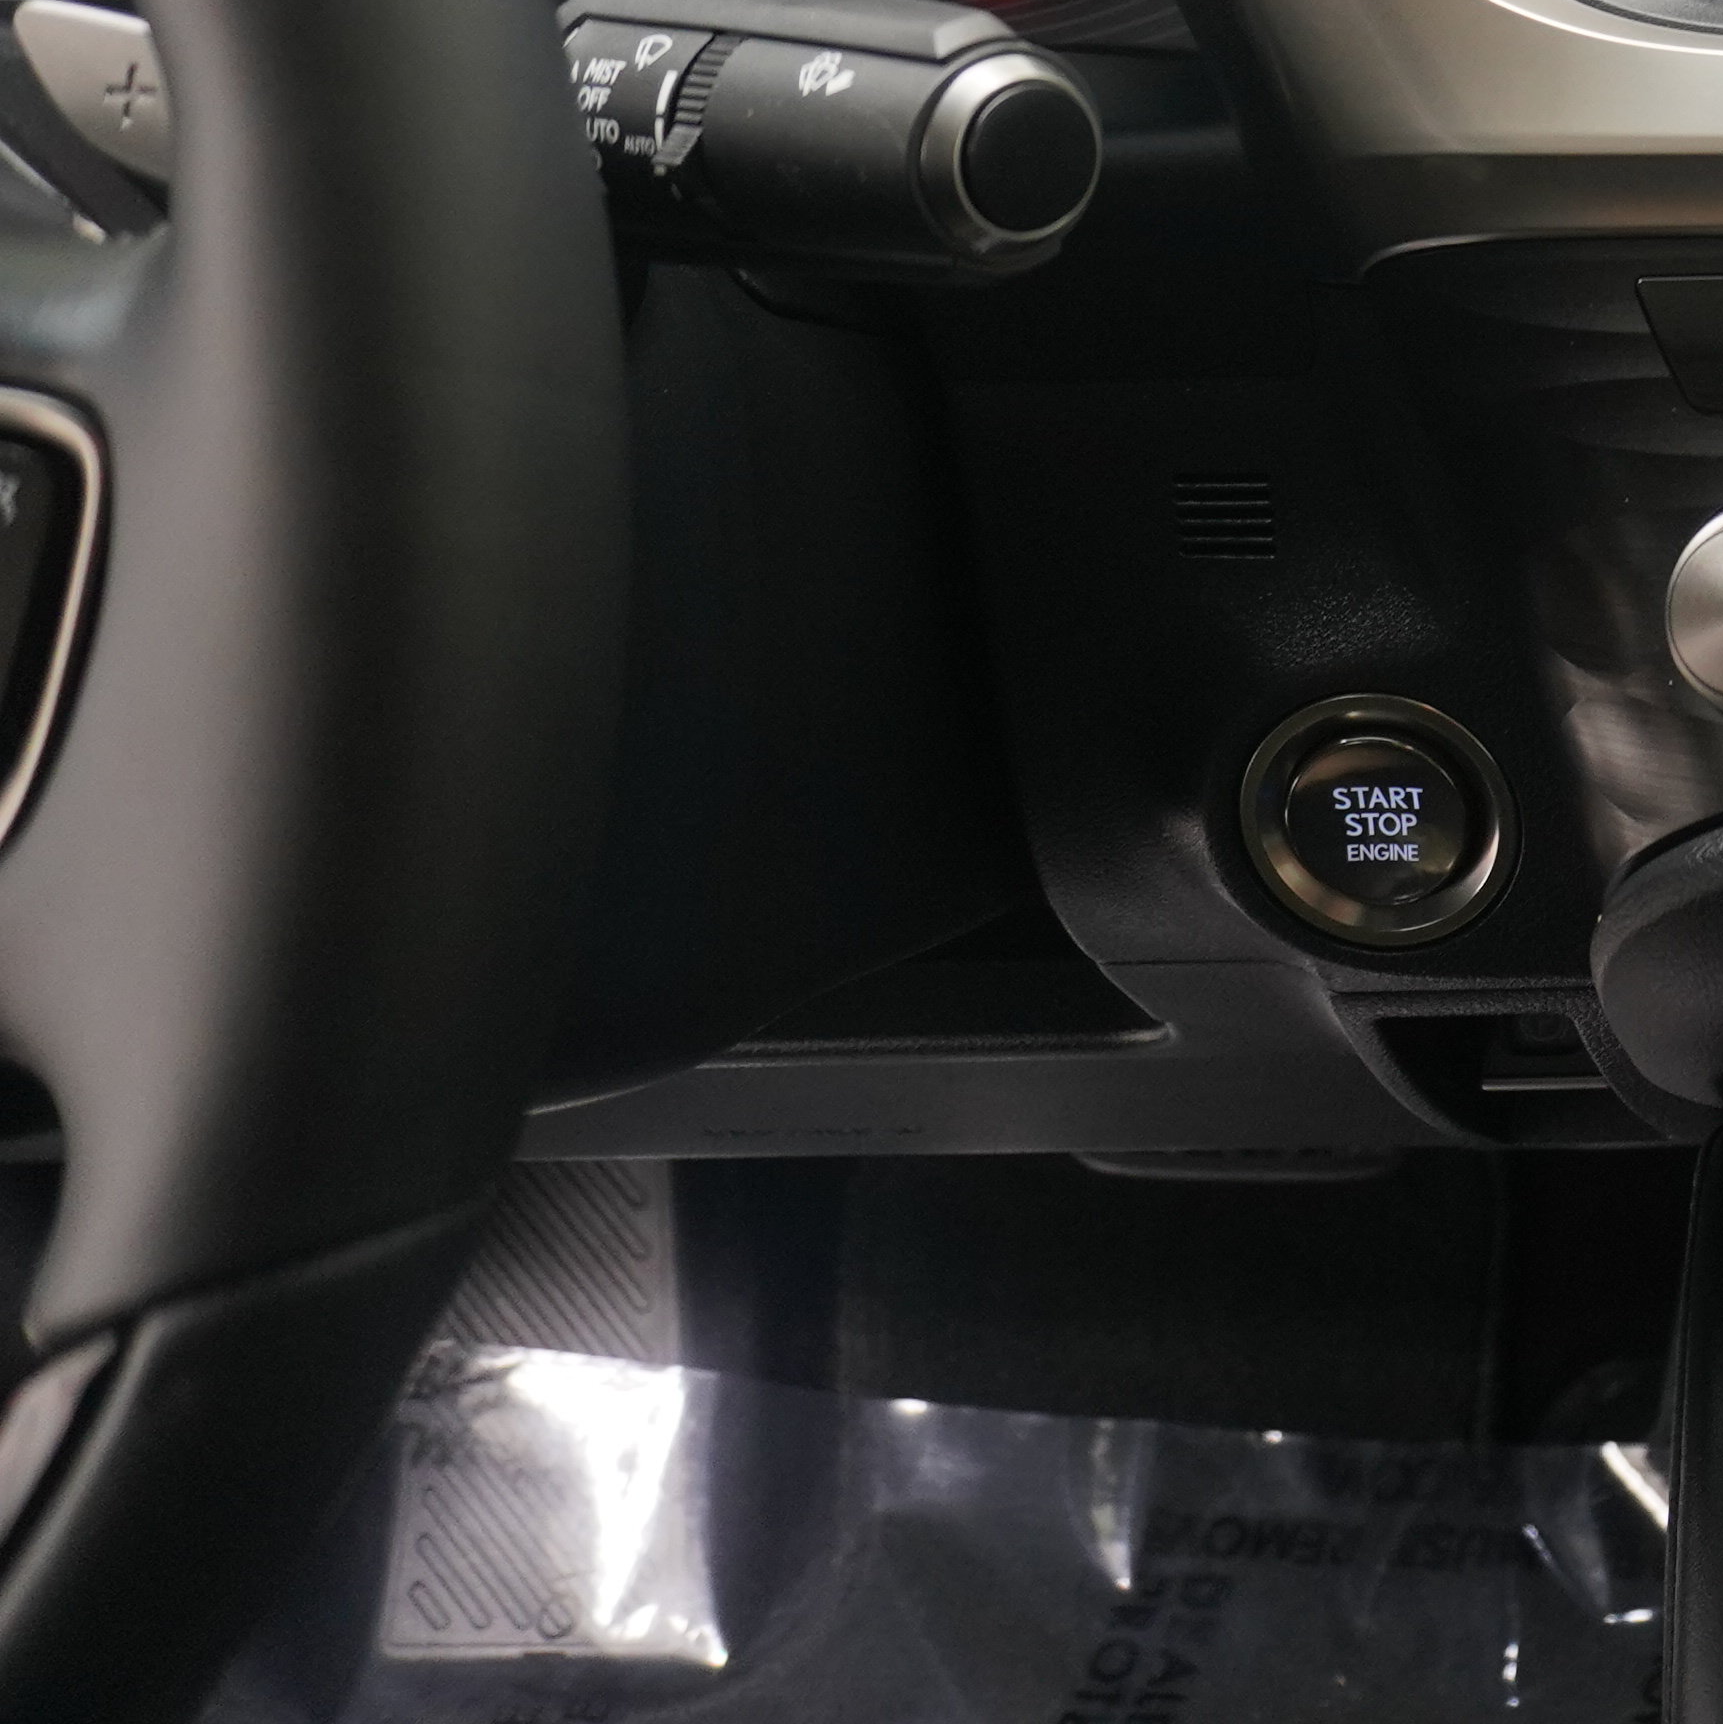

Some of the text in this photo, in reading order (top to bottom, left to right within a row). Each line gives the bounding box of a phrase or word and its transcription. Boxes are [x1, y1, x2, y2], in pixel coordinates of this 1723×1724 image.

[577, 86, 611, 112] OFF
[584, 117, 620, 144] UTO
[1333, 787, 1422, 809] START
[1345, 813, 1417, 836] STOP
[1347, 844, 1419, 861] ENGINE
